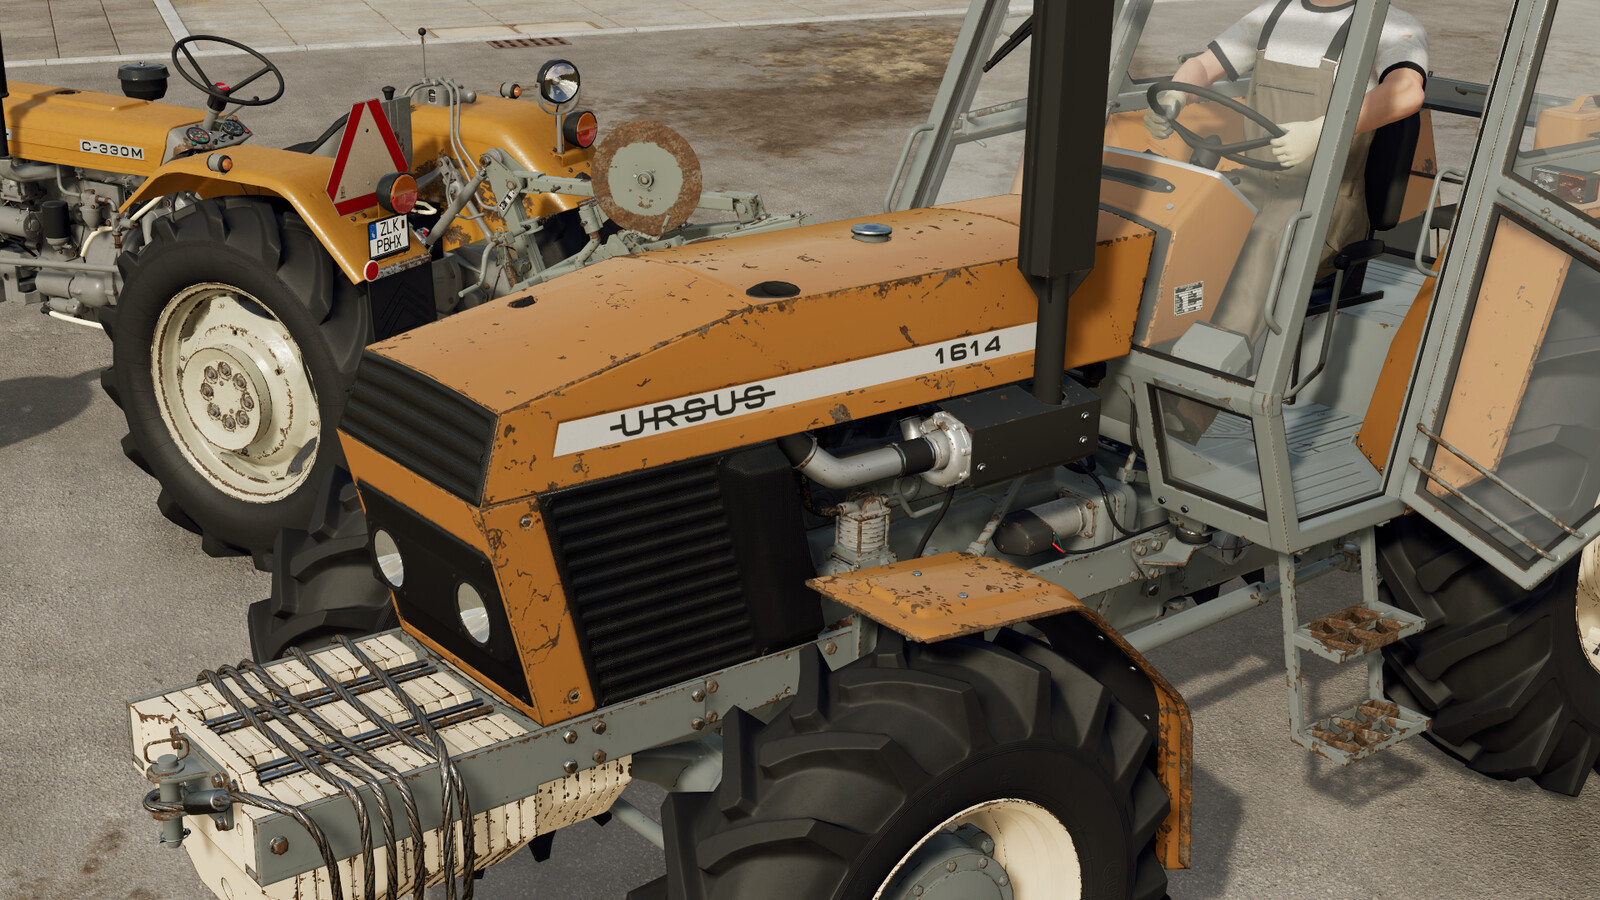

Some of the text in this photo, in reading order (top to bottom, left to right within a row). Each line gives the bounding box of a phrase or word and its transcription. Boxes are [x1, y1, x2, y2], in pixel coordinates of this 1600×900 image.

[82, 141, 143, 159] C-330M
[380, 217, 399, 236] ZLK
[377, 233, 402, 254] PBHX
[610, 336, 1001, 437] URSUS 1614
